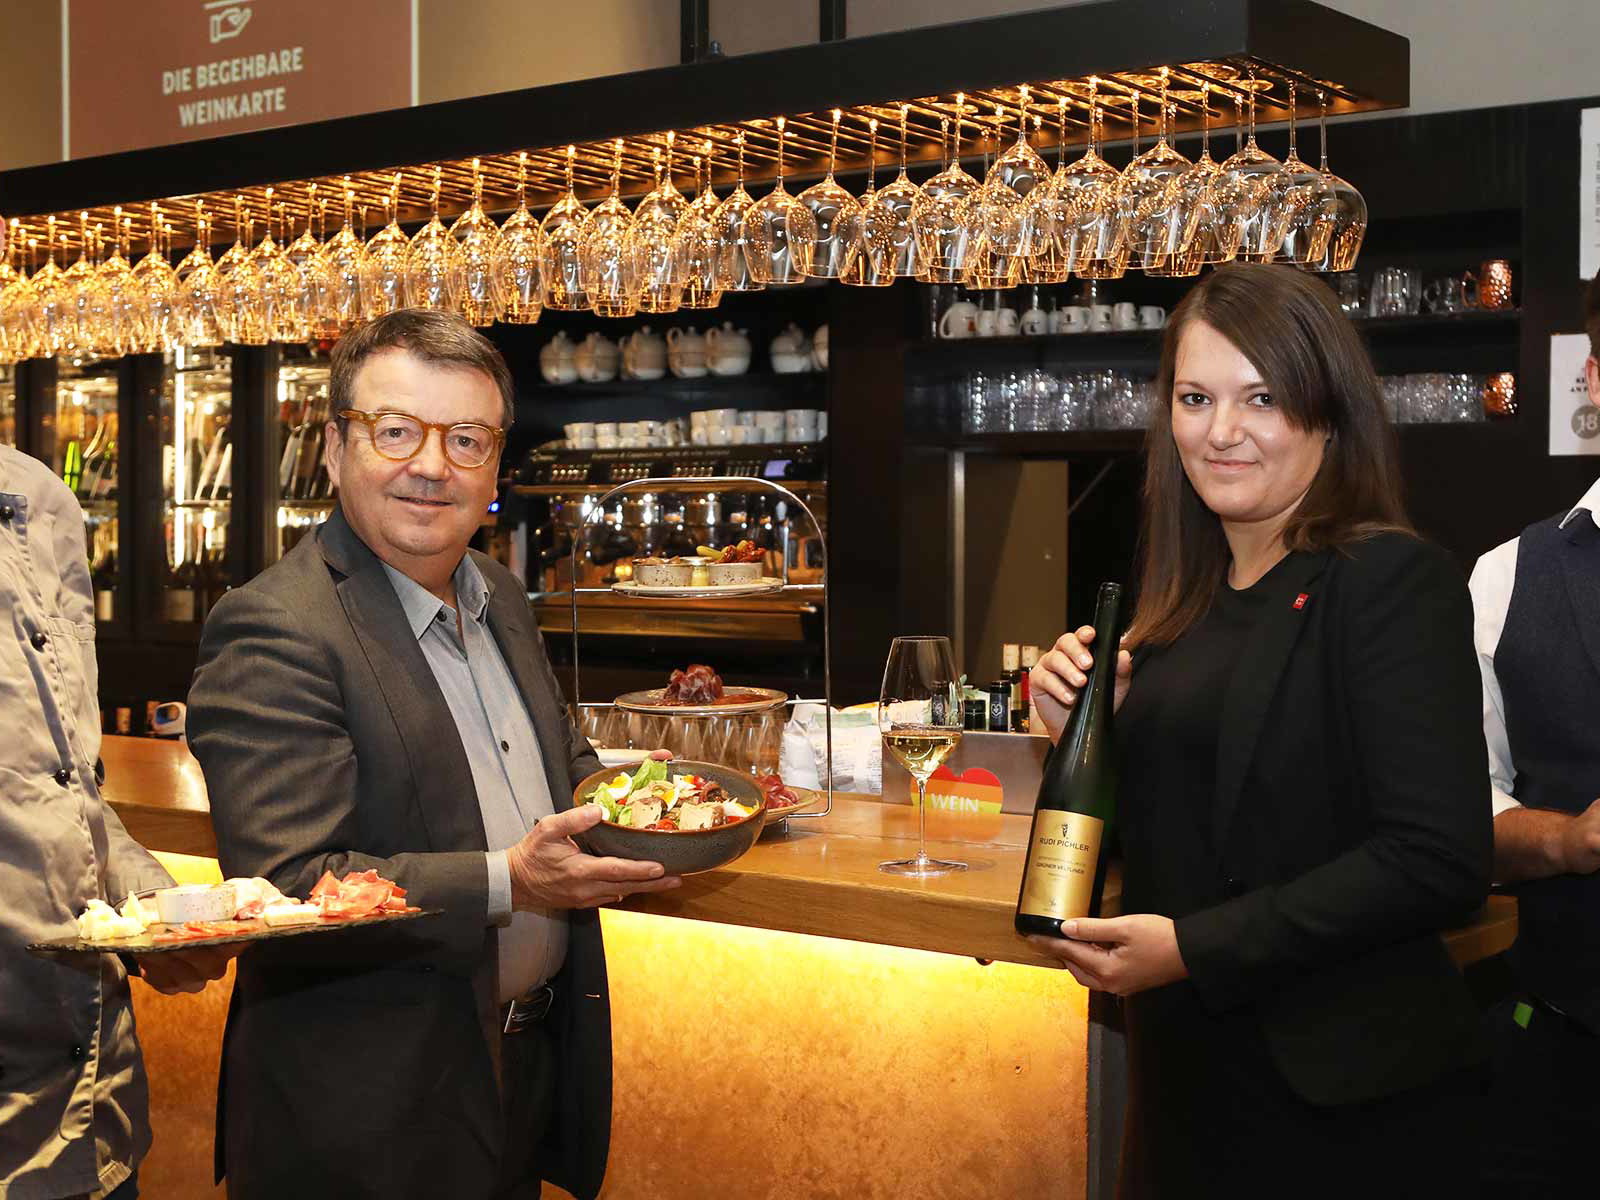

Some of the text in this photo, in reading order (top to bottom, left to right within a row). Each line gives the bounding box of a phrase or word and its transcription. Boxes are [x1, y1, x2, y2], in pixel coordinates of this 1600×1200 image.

[162, 47, 304, 95] DIE BEGEHBARE
[179, 87, 286, 127] WEINKARTE
[931, 793, 979, 813] WEIN
[1040, 837, 1090, 852] RUDI PICHLER
